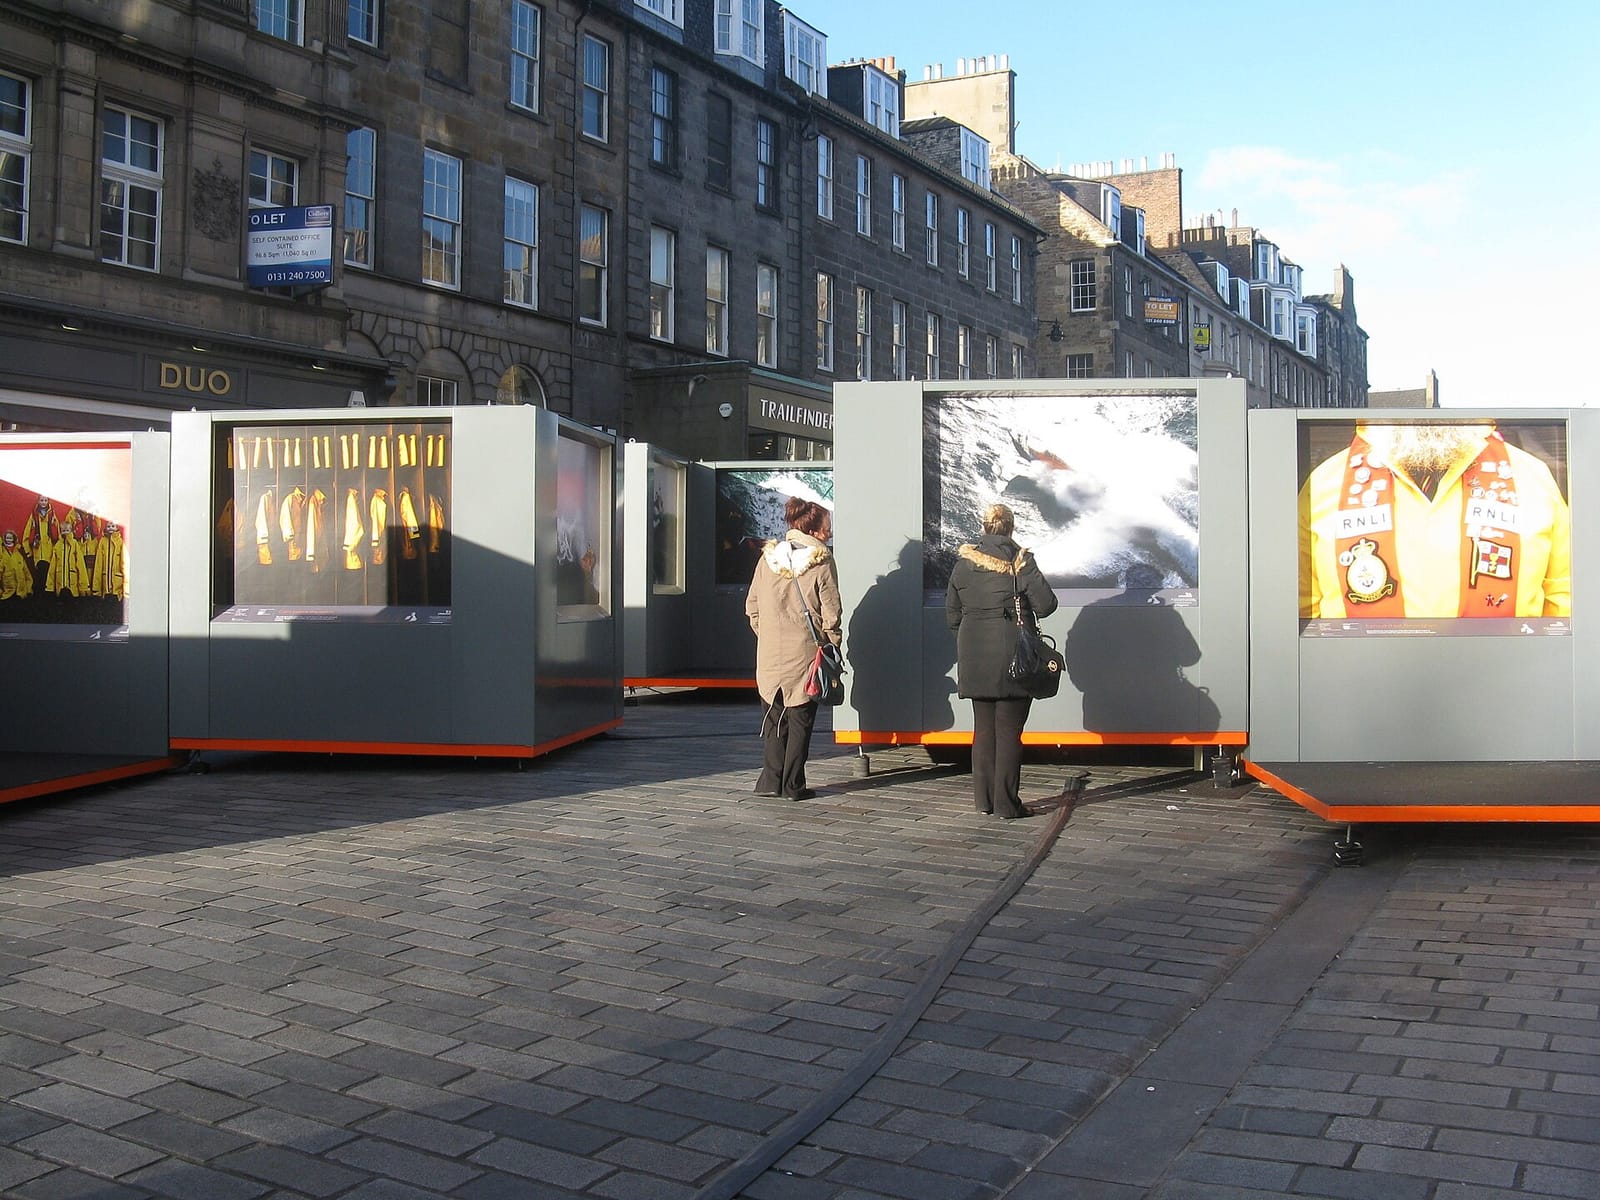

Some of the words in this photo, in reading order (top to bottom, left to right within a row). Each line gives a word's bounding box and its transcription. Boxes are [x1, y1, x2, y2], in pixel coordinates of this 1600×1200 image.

[249, 214, 260, 225] O
[263, 213, 286, 225] LET
[252, 236, 265, 244] SELF
[267, 235, 299, 243] CONTAINED
[267, 272, 286, 281] 0131
[288, 271, 304, 280] 240
[305, 270, 325, 279] 7500
[1159, 303, 1173, 311] LET
[160, 362, 231, 395] DUO
[1343, 513, 1386, 530] RNLI
[1473, 507, 1516, 524] RNLI
